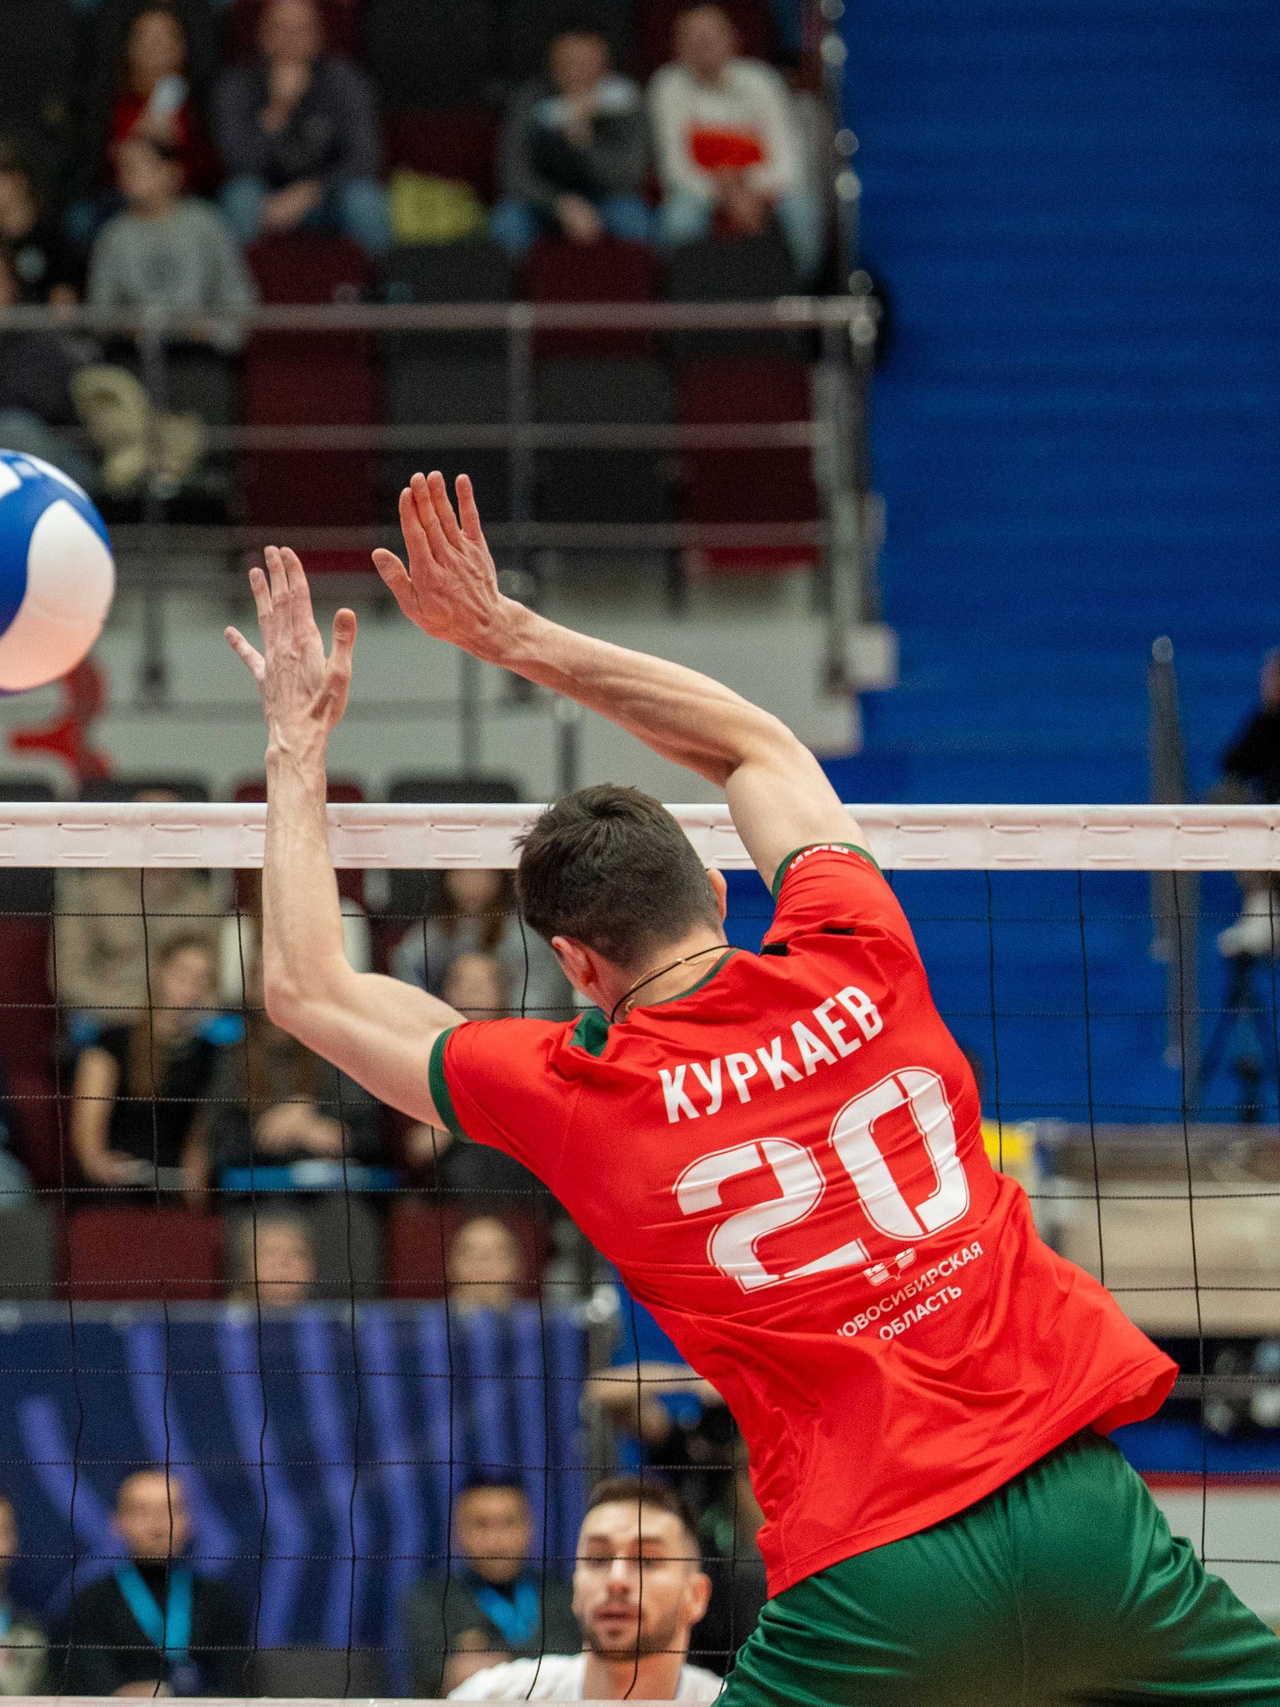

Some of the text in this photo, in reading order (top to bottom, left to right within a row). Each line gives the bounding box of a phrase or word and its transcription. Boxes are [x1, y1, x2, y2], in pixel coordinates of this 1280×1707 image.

[657, 985, 884, 1124] КУРКАЕВ
[671, 1065, 971, 1296] 20
[836, 1240, 985, 1338] ОВОСИБИРСКАЯ
[878, 1284, 963, 1341] ОБЛАСТЬ
